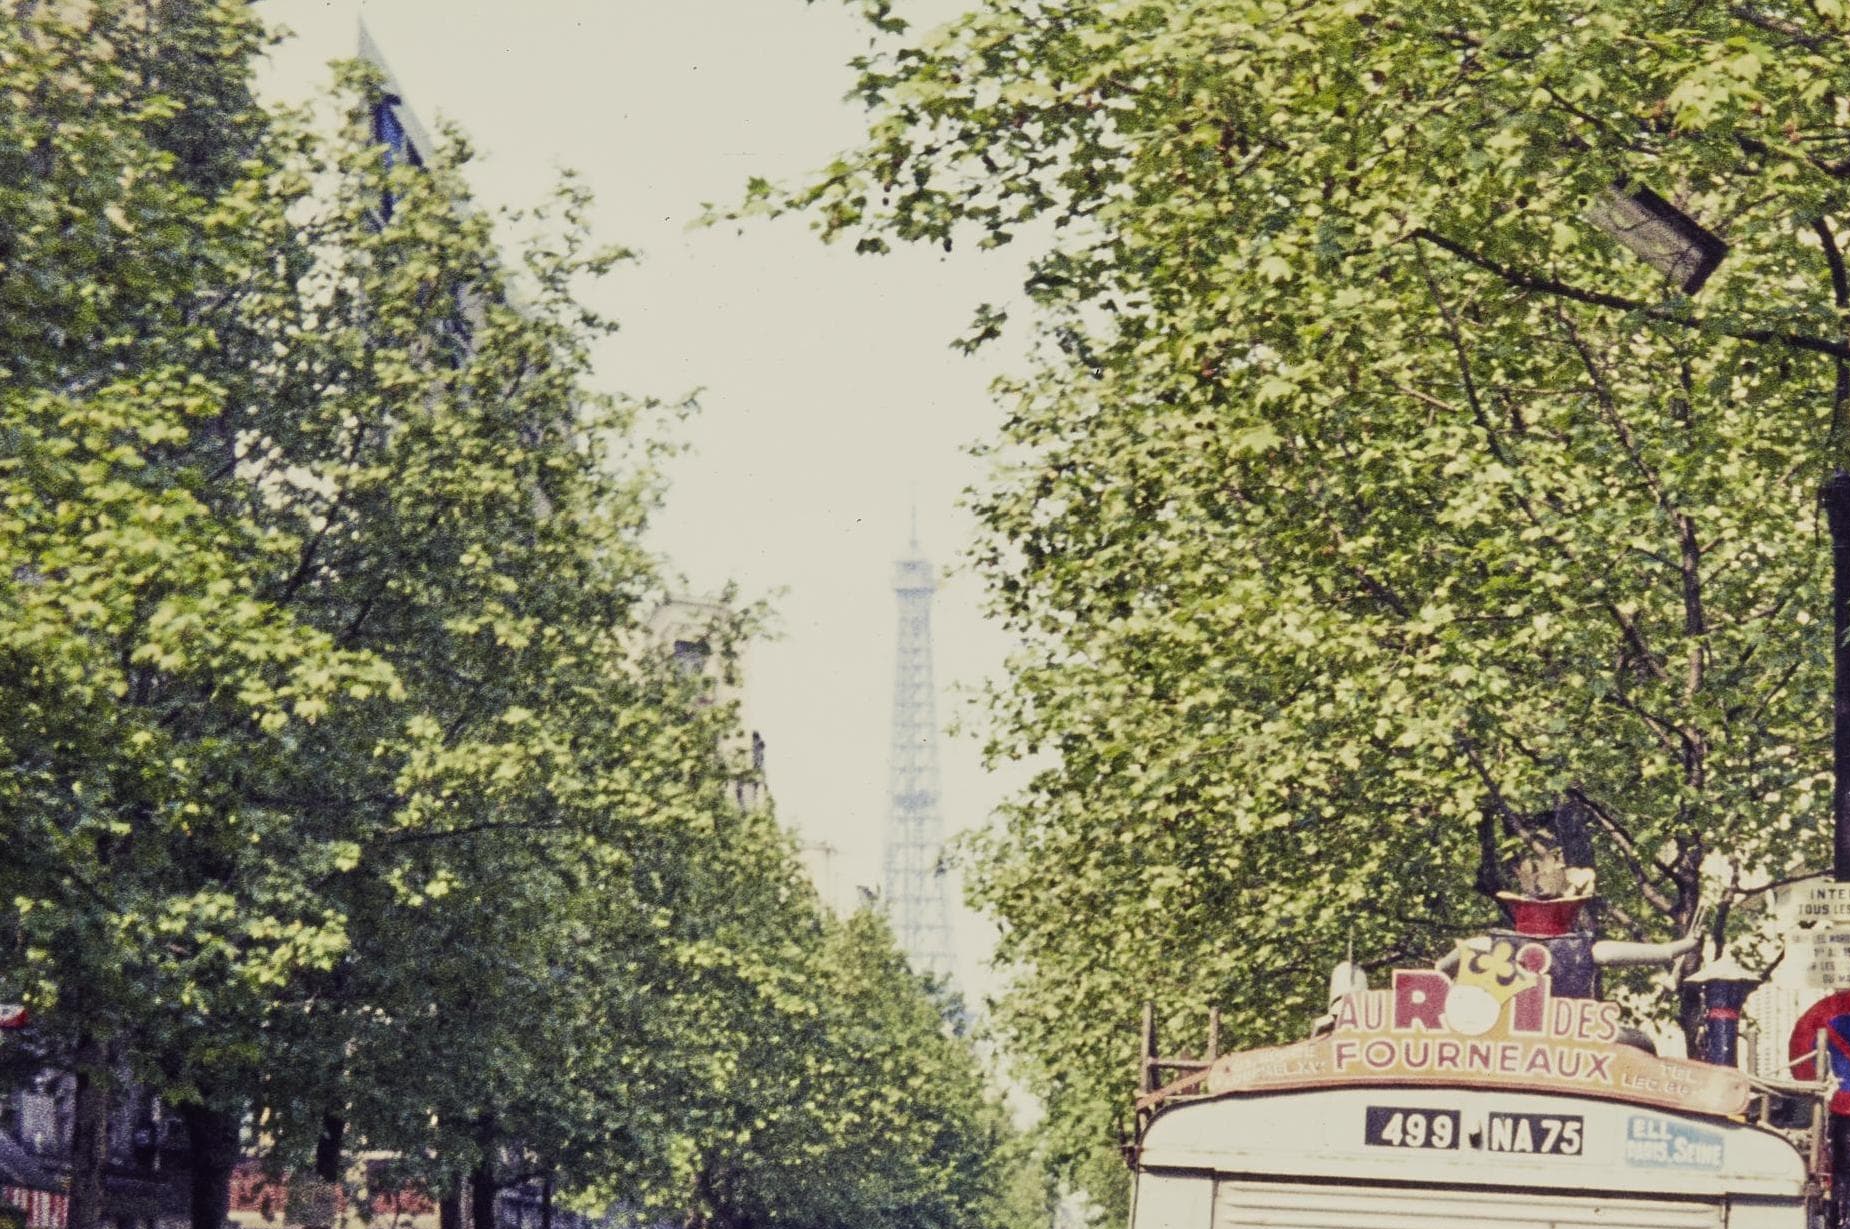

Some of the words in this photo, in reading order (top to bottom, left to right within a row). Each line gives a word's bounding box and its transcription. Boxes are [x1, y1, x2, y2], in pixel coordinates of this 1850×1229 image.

[1335, 991, 1383, 1031] AU
[1553, 999, 1619, 1042] DES
[1334, 1039, 1613, 1083] FOURNEAUX
[1381, 1113, 1454, 1148] 499
